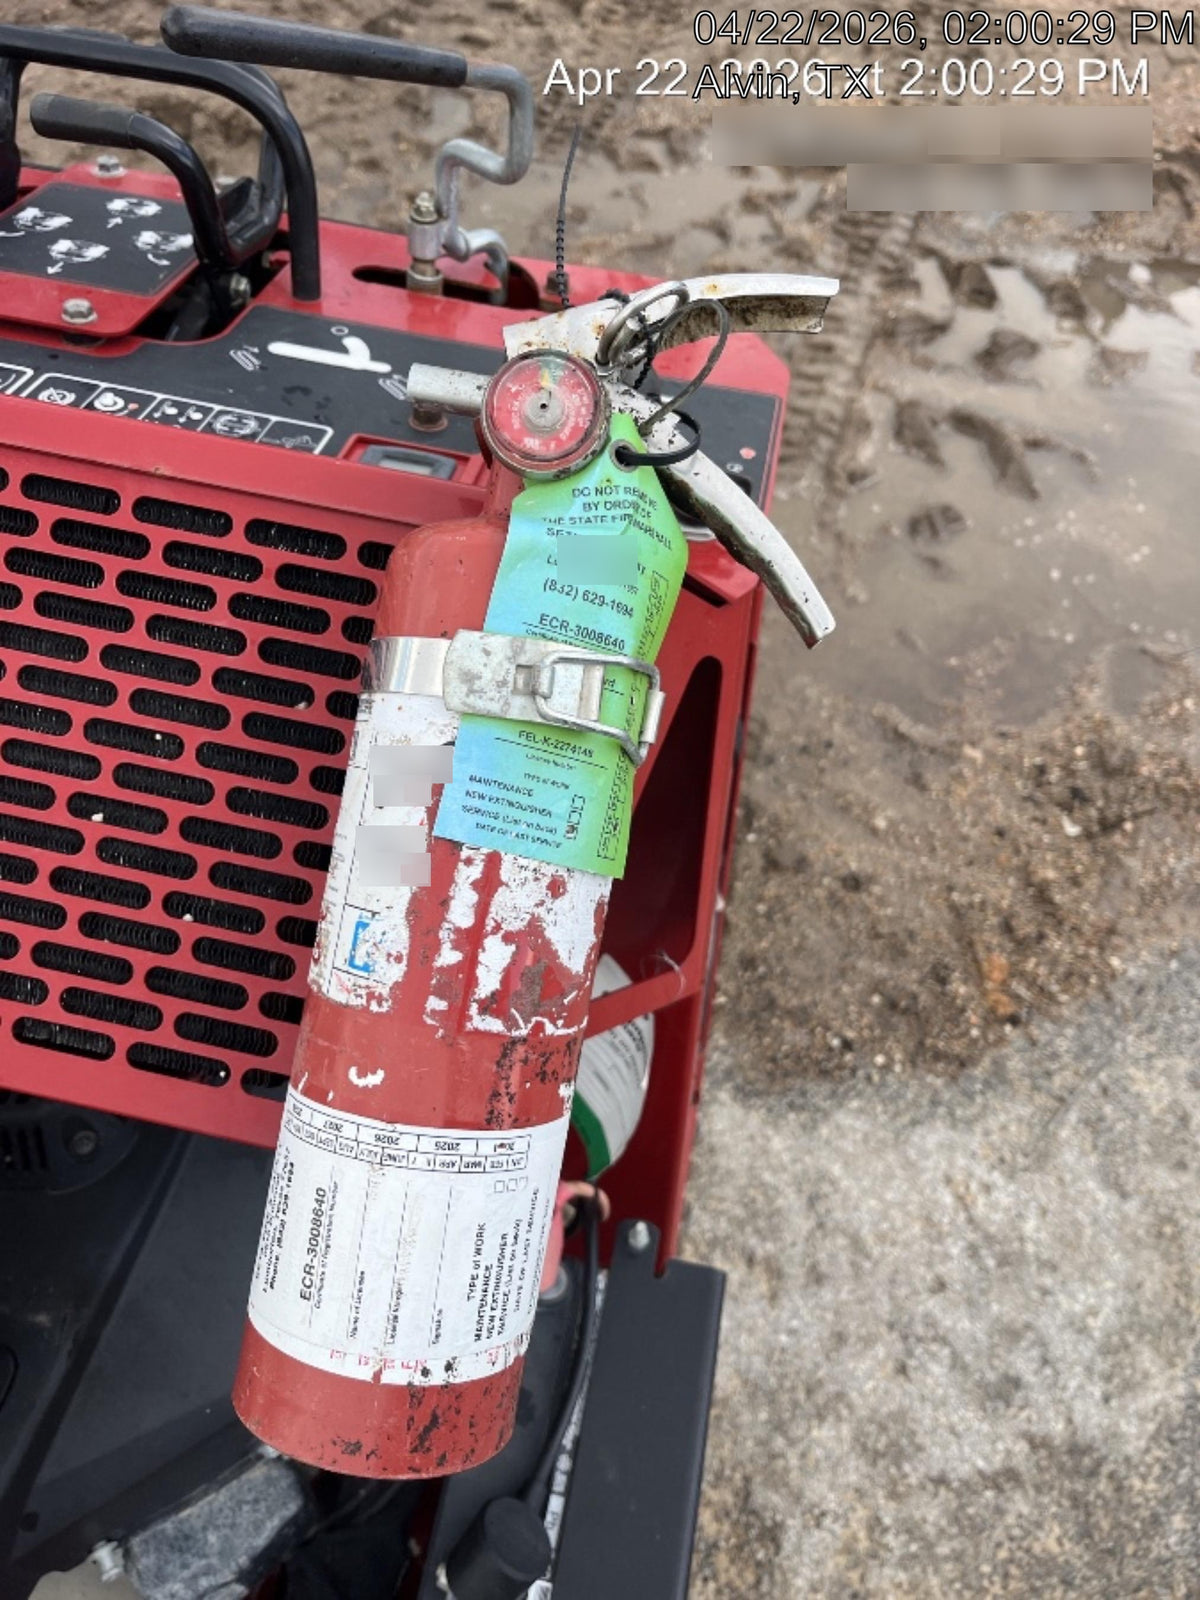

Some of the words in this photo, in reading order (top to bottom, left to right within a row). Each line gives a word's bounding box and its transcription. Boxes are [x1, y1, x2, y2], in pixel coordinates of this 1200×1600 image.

[572, 487, 591, 498] DO
[595, 485, 620, 497] NOT
[568, 515, 607, 525] STATE
[583, 501, 600, 512] BY
[543, 577, 579, 602] (832)
[539, 612, 626, 652] ECR-3008640
[373, 1132, 401, 1147] 2026
[434, 1140, 461, 1152] 2025
[300, 1186, 328, 1302] ECR-3008640
[473, 1222, 487, 1258] WORK
[467, 1273, 480, 1302] TYPE
[473, 1263, 494, 1342] MAINTENANCE
